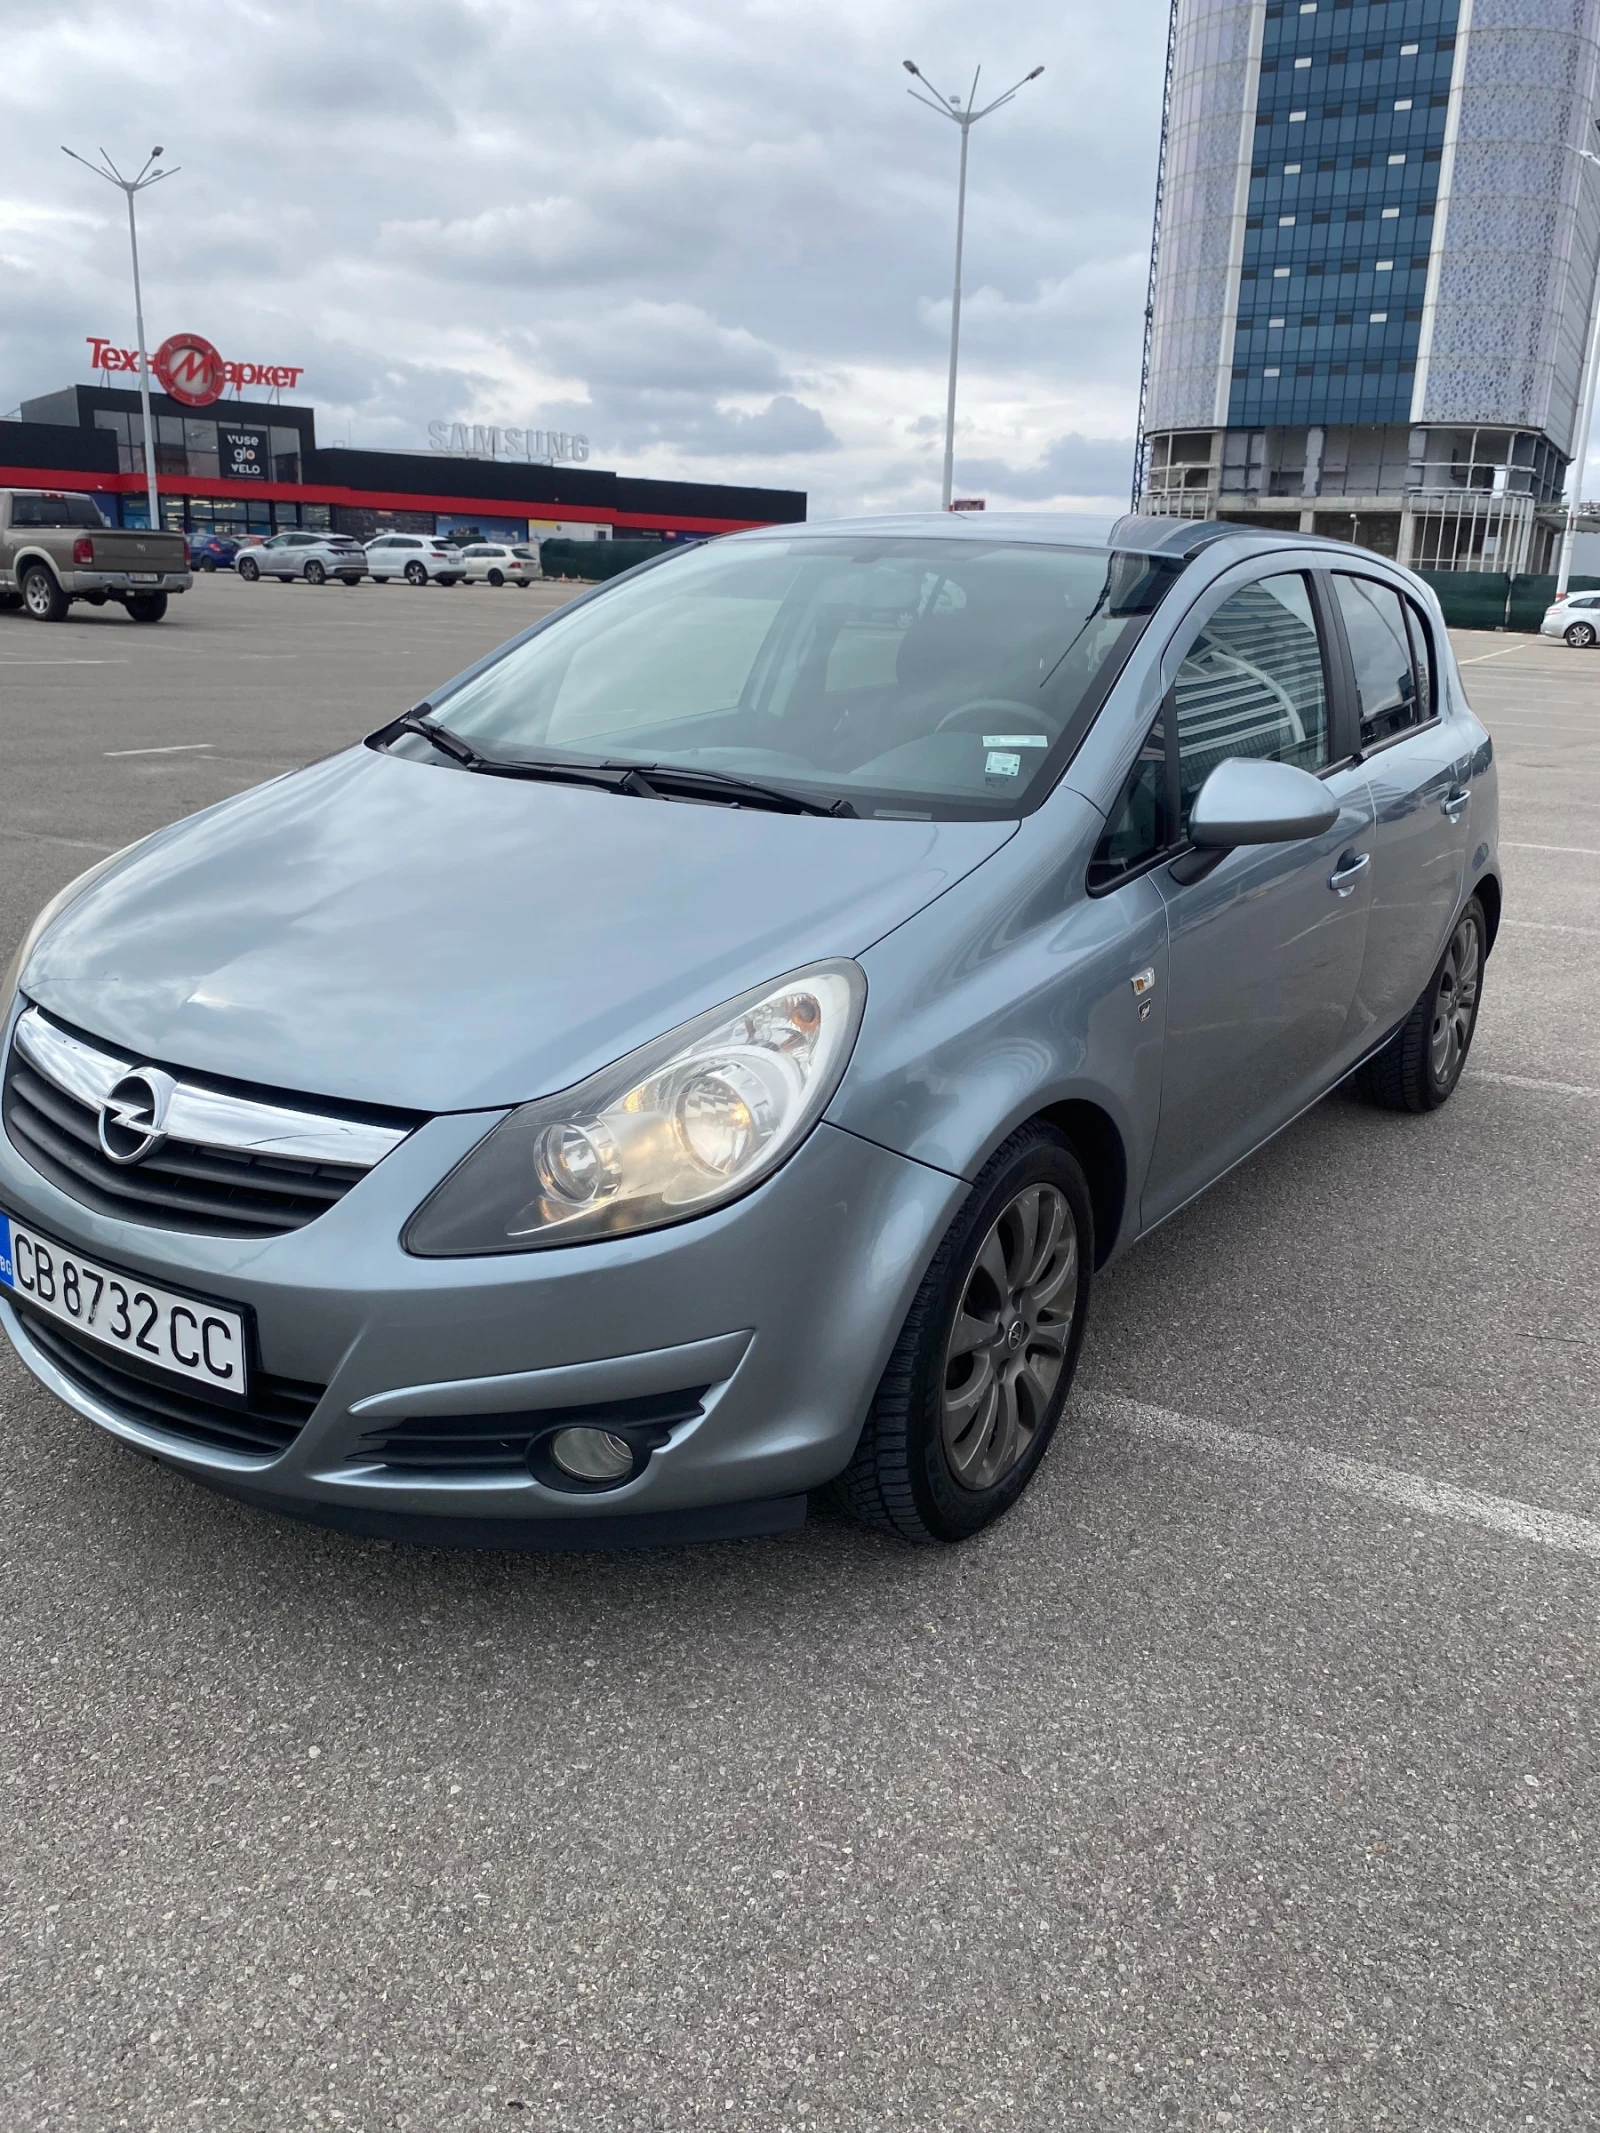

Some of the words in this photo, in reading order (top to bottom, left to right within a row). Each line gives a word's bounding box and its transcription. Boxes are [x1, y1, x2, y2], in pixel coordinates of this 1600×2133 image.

[428, 420, 589, 463] SAMSUNG
[233, 446, 256, 463] glo
[231, 463, 261, 474] VELO
[0, 1254, 12, 1276] BG
